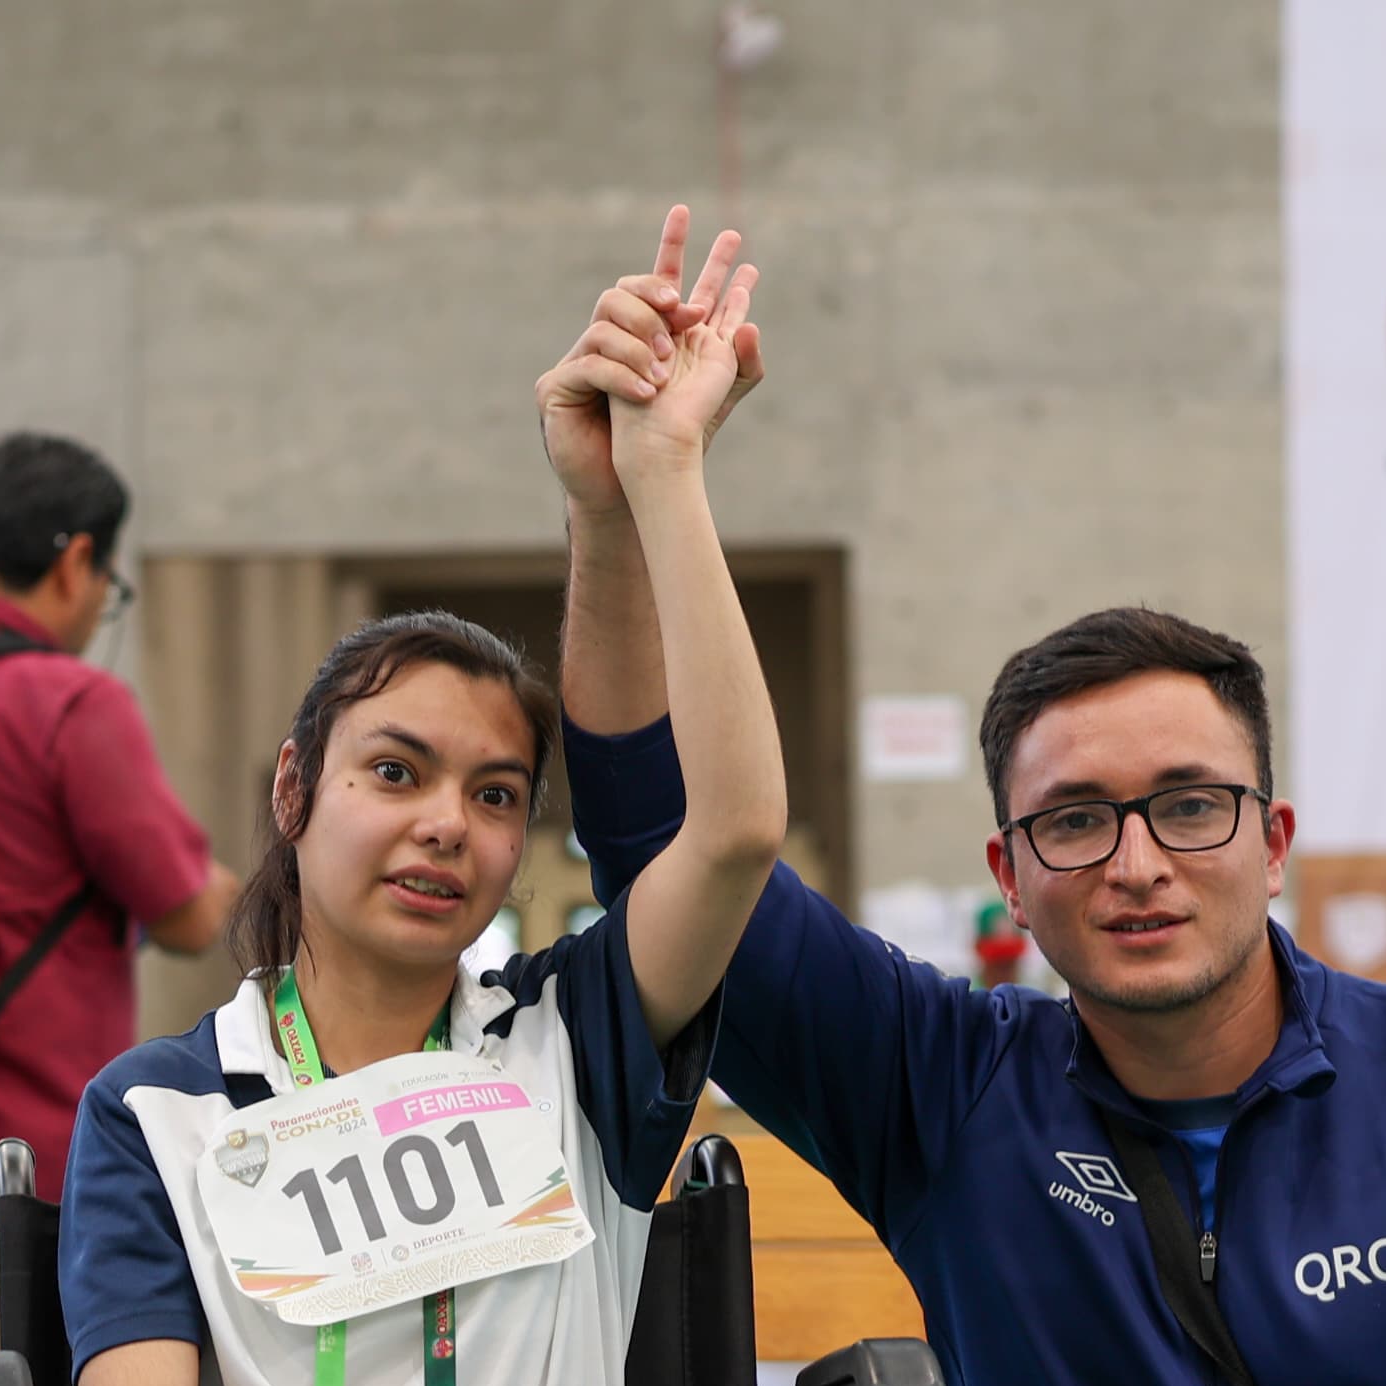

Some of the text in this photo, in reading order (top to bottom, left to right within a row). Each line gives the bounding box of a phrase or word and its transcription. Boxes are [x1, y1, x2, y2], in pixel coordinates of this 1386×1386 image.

[270, 1098, 359, 1131] Paranacionales
[402, 1087, 512, 1121] FEMENIL
[275, 1106, 363, 1142] CONADE
[336, 1117, 367, 1136] 2024
[282, 1120, 505, 1256] 1101
[1048, 1181, 1115, 1226] umbro
[413, 1227, 466, 1249] DEPORTE
